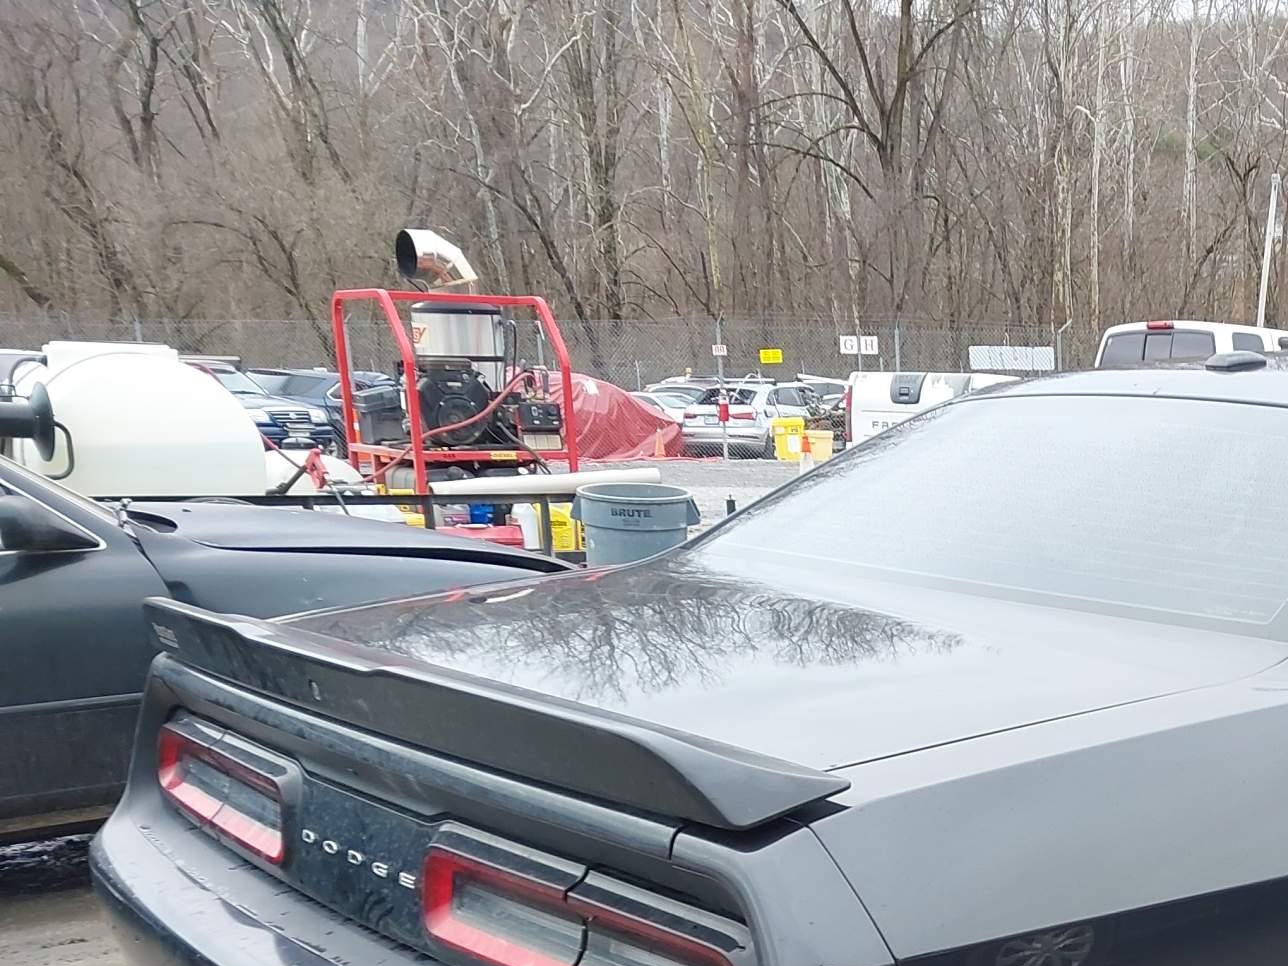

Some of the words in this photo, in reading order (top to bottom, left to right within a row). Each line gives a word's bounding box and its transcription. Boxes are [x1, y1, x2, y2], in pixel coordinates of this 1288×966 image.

[844, 339, 854, 350] G
[864, 339, 874, 351] H
[611, 508, 653, 518] BRUTE
[302, 829, 416, 889] DODGE
